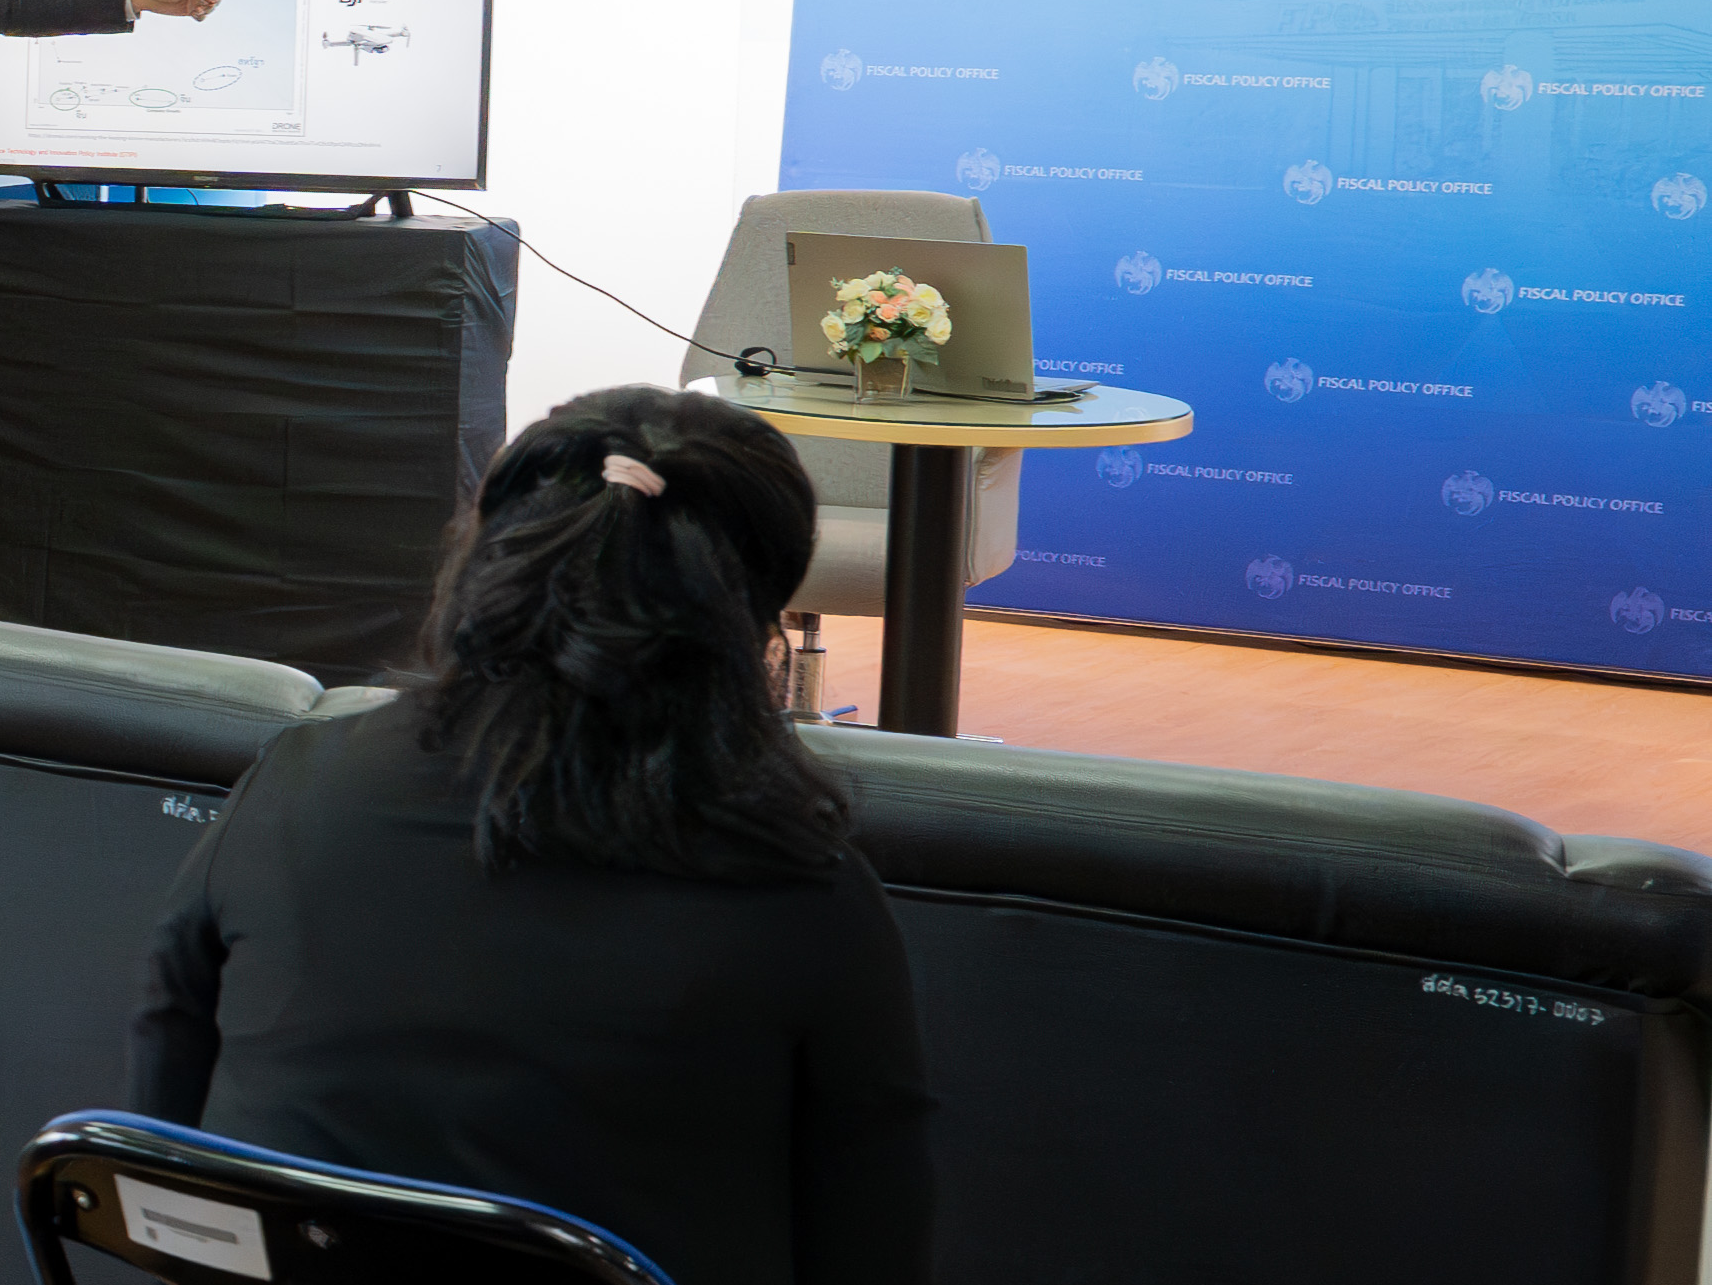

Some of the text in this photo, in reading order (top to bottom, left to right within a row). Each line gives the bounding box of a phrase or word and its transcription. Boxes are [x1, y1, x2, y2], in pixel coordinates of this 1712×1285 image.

[867, 66, 998, 79] FISCAL POLICY OFFICE
[1184, 74, 1330, 88] FISCAL POLICY OFFICE
[1538, 82, 1705, 97] FISCAL POLICY OFFICE
[1004, 165, 1143, 180] FISCAL POLICY OFFICE
[1337, 177, 1492, 194] FISCAL POLICY OFFICE
[1166, 269, 1313, 287] FISCAL POLICY OFFICE
[1518, 287, 1684, 306] FISCAL POLICY OFFICE
[1079, 361, 1125, 375] OFFICE
[1318, 377, 1473, 397] FISCAL POLICY OFFICE
[1147, 464, 1292, 484] FISCAL POLICY OFFICE
[1498, 491, 1662, 514] FISCAL POLICY OFFICE
[1298, 575, 1452, 598] FISCAL POLICY OFFICE
